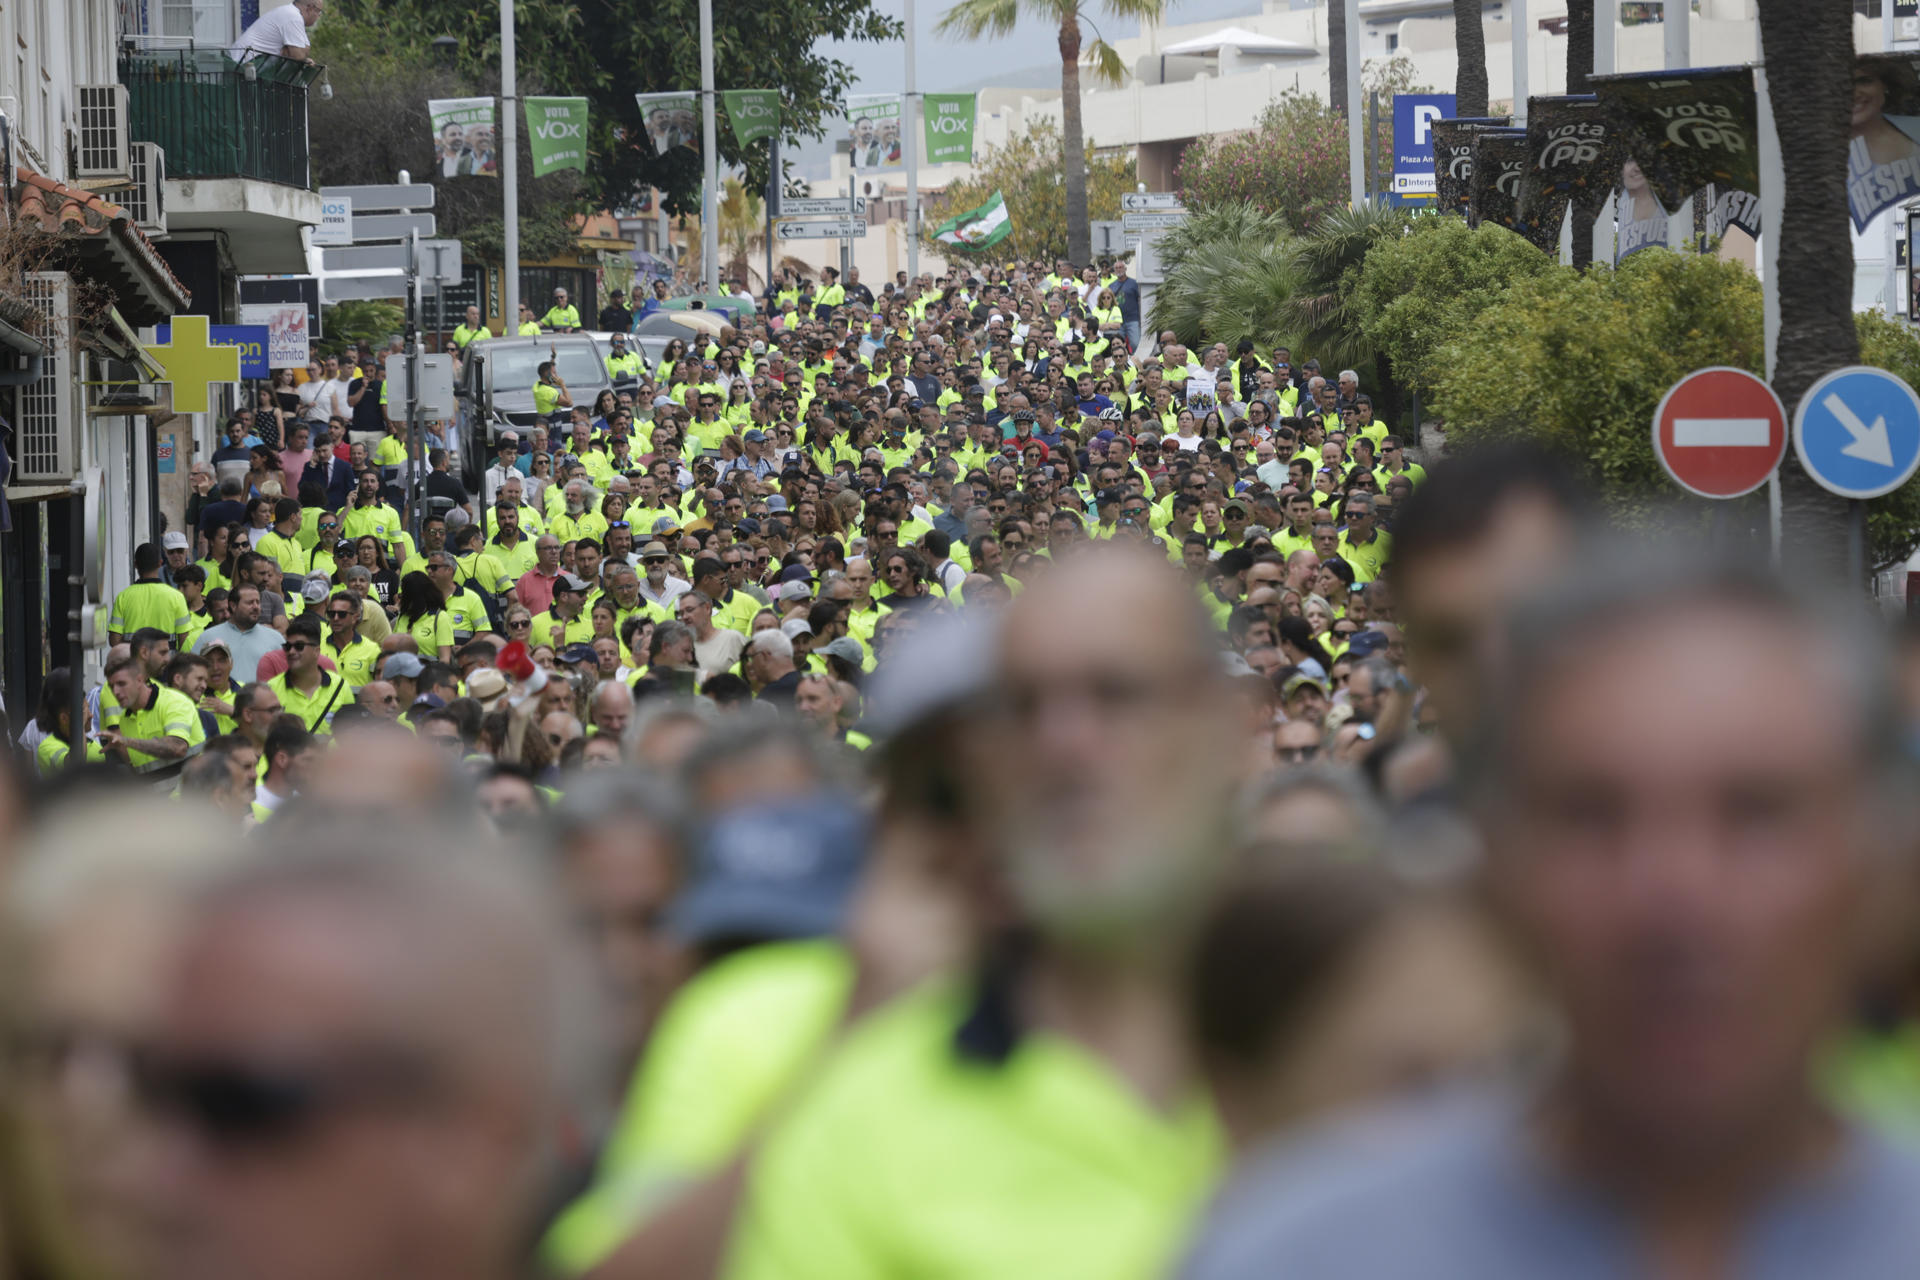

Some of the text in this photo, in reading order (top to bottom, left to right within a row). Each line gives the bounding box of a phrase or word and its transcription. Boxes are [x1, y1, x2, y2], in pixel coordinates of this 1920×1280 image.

[544, 107, 570, 118] VOTA
[736, 104, 774, 119] VOX
[939, 102, 960, 113] VOTA
[1653, 101, 1732, 119] vota
[536, 120, 580, 139] VOX
[930, 115, 968, 134] VOX
[1414, 105, 1442, 145] P
[1548, 122, 1605, 139] vota
[283, 330, 307, 343] Nails
[270, 349, 305, 361] namita
